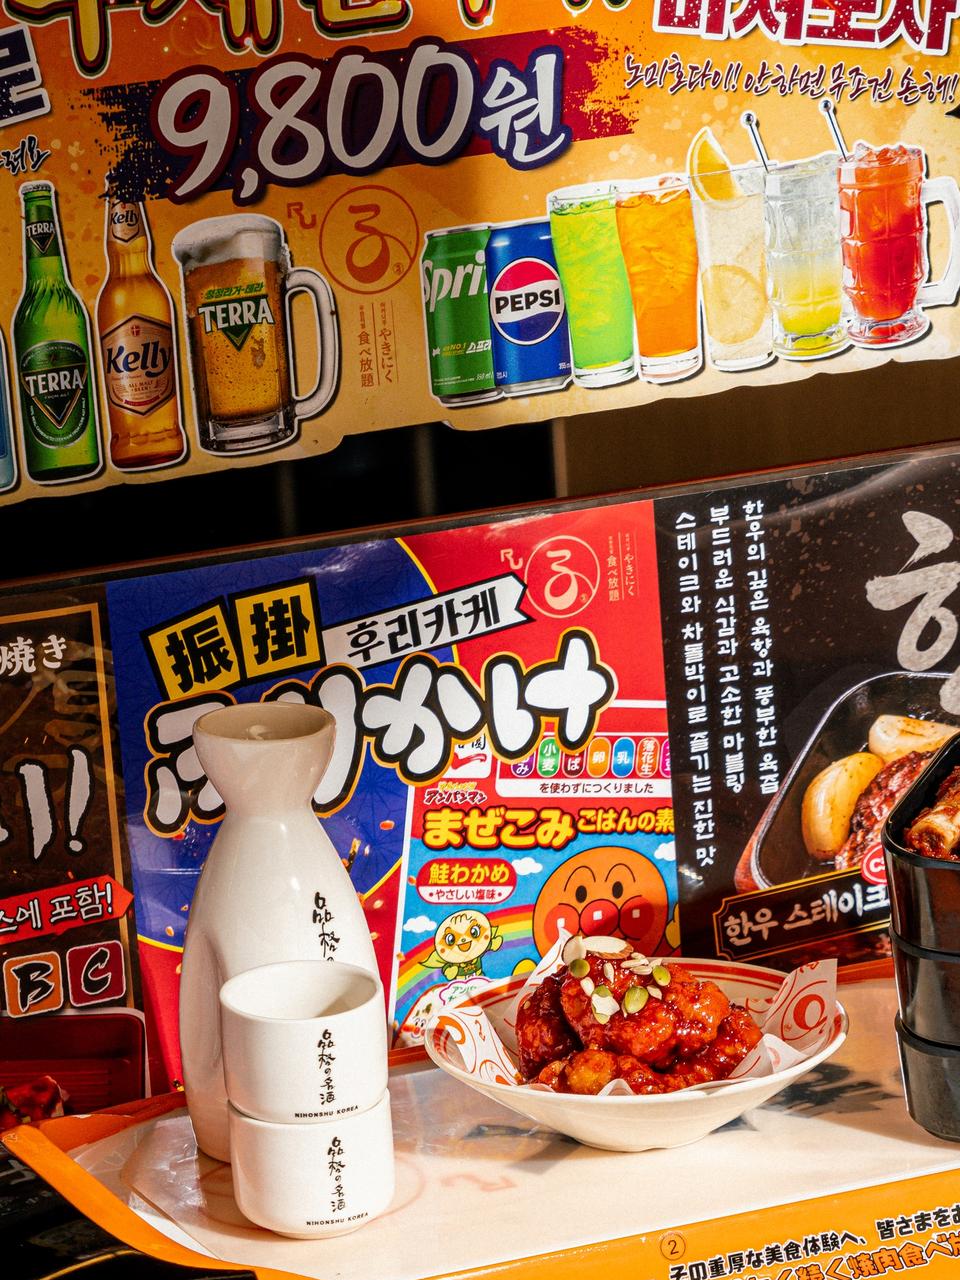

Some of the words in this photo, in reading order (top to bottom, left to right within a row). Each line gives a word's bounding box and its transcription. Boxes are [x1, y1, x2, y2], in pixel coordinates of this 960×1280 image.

[624, 53, 741, 94] 노미호다이!!
[826, 62, 893, 101] 무조건
[896, 66, 960, 105] 손해!
[157, 45, 566, 198] 9,800원
[26, 222, 56, 237] TERRA
[110, 206, 139, 226] Kelly
[199, 298, 274, 333] TERRA
[495, 288, 560, 314] PEPSI
[26, 367, 86, 397] TERRA
[106, 340, 171, 376] Kelly
[358, 331, 374, 388] 食べ放題
[710, 506, 735, 590] 부드러운
[743, 500, 767, 563] 한우의
[676, 512, 702, 614] 스테이크와
[747, 572, 769, 611] 깊은
[166, 595, 311, 693] 振掛
[346, 586, 501, 661] 후리카케
[715, 596, 738, 656] 식감과
[682, 622, 708, 725] 차돌박이로
[718, 665, 742, 727] 고소한
[754, 687, 777, 748] 풍부한
[539, 781, 654, 794] を使わずにつくりました
[689, 732, 712, 794] 즐기는
[723, 732, 744, 794] 마블링
[758, 755, 779, 796] 육즙
[423, 807, 575, 849] まぜこみ
[578, 807, 676, 836] ごはんの素
[693, 799, 715, 842] 진한
[429, 862, 511, 884] 鮭わかめ
[696, 847, 717, 867] 맛
[50, 882, 113, 924] 포함!
[435, 888, 497, 901] やさしい塩味
[724, 907, 778, 946] 한우
[783, 883, 890, 930] 스테이크
[16, 960, 55, 1014] B
[80, 948, 111, 996] C
[317, 1029, 338, 1106] 品格の名酒
[294, 1111, 334, 1119] NIHONSHU
[336, 1105, 359, 1114] KOREA
[327, 1136, 347, 1213] 品格の名酒
[306, 1217, 345, 1226] NIHONSHU
[347, 1211, 369, 1221] KOREA
